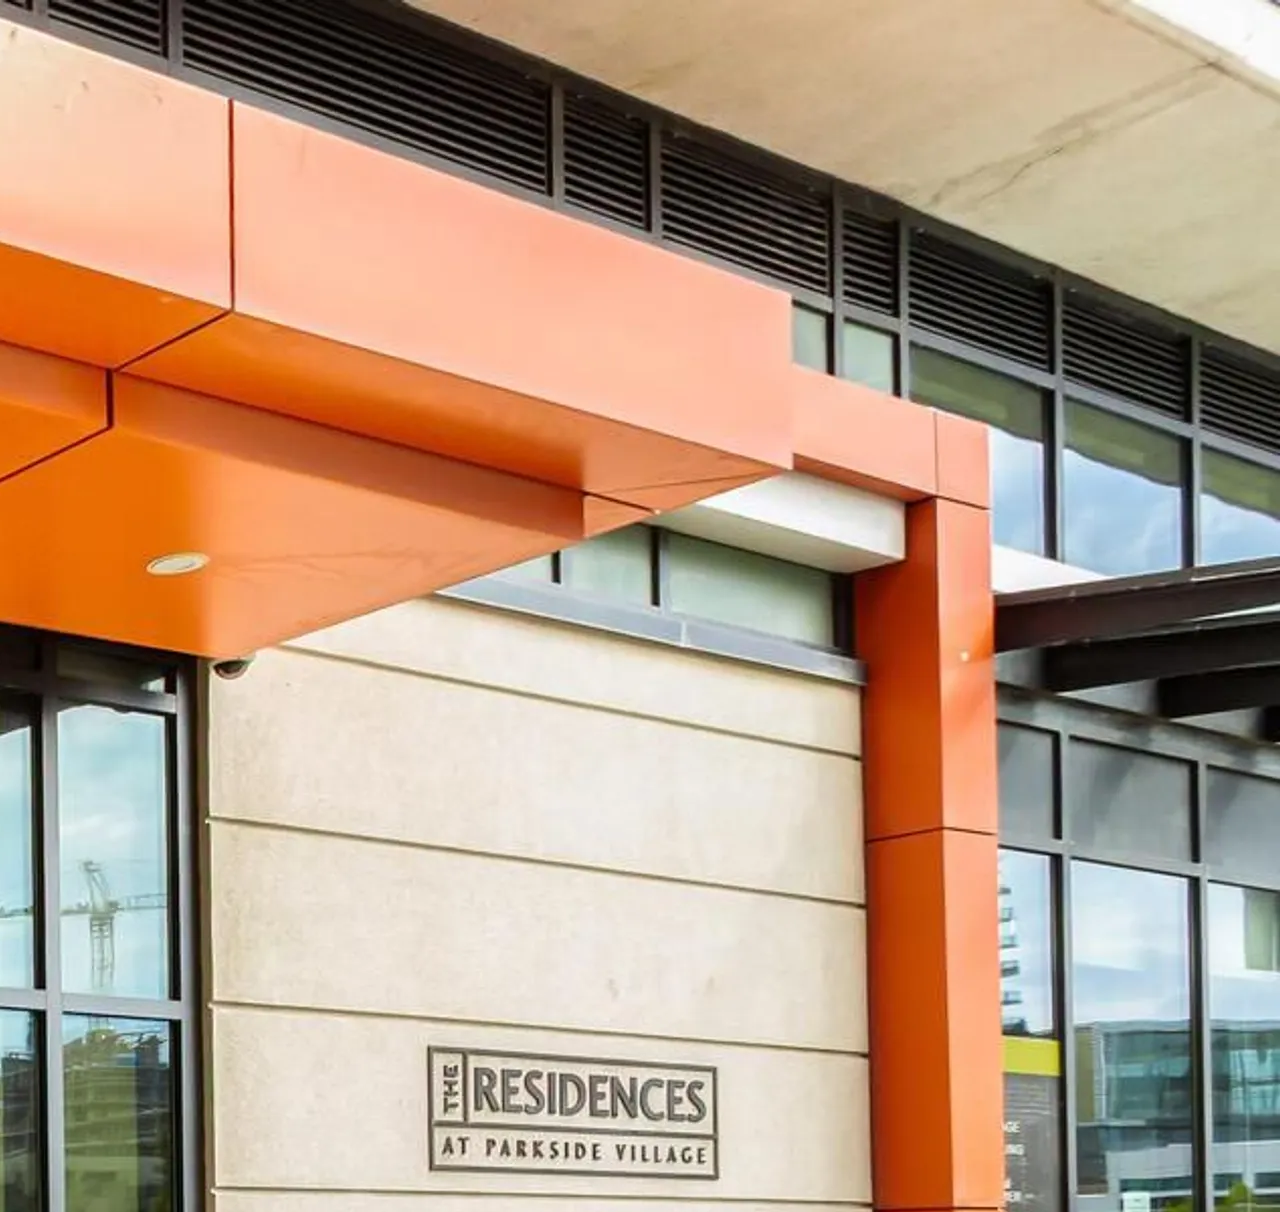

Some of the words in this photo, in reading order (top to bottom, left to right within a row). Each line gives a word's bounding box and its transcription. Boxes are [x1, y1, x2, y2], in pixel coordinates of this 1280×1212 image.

[442, 1064, 459, 1116] THE
[473, 1067, 707, 1123] RESIDENCES
[441, 1136, 470, 1155] AT
[485, 1138, 602, 1161] PARKSIDE
[616, 1143, 707, 1165] VILLAGE
